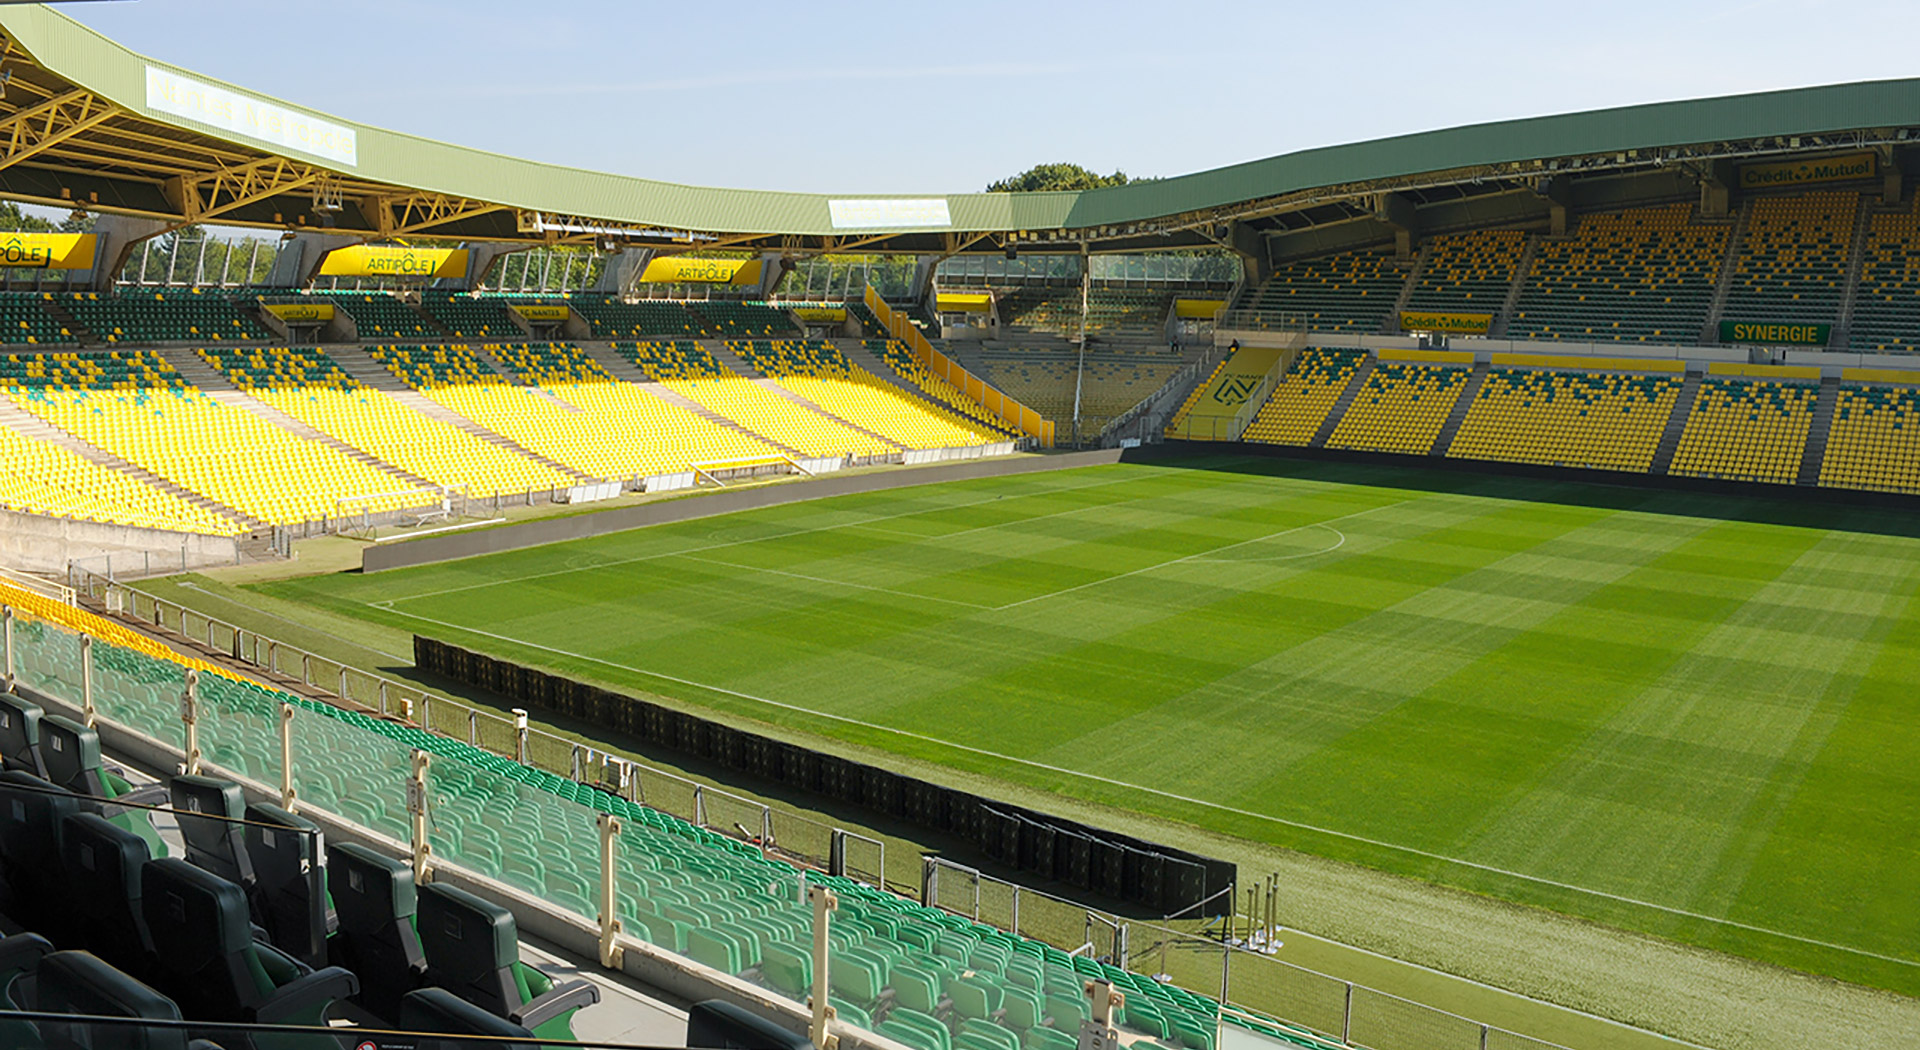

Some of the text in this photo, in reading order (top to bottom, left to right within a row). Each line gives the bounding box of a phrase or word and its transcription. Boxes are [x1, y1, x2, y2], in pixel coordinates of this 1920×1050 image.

[151, 72, 233, 121] Nantes
[1745, 160, 1870, 184] Crédit Mutuel
[366, 252, 429, 273] ARTIPÔLE
[676, 262, 728, 281] ARTIPÔLE
[532, 309, 560, 317] NANTES
[1404, 316, 1489, 329] Crédit Mutuel
[1734, 324, 1818, 343] SYNERGIE
